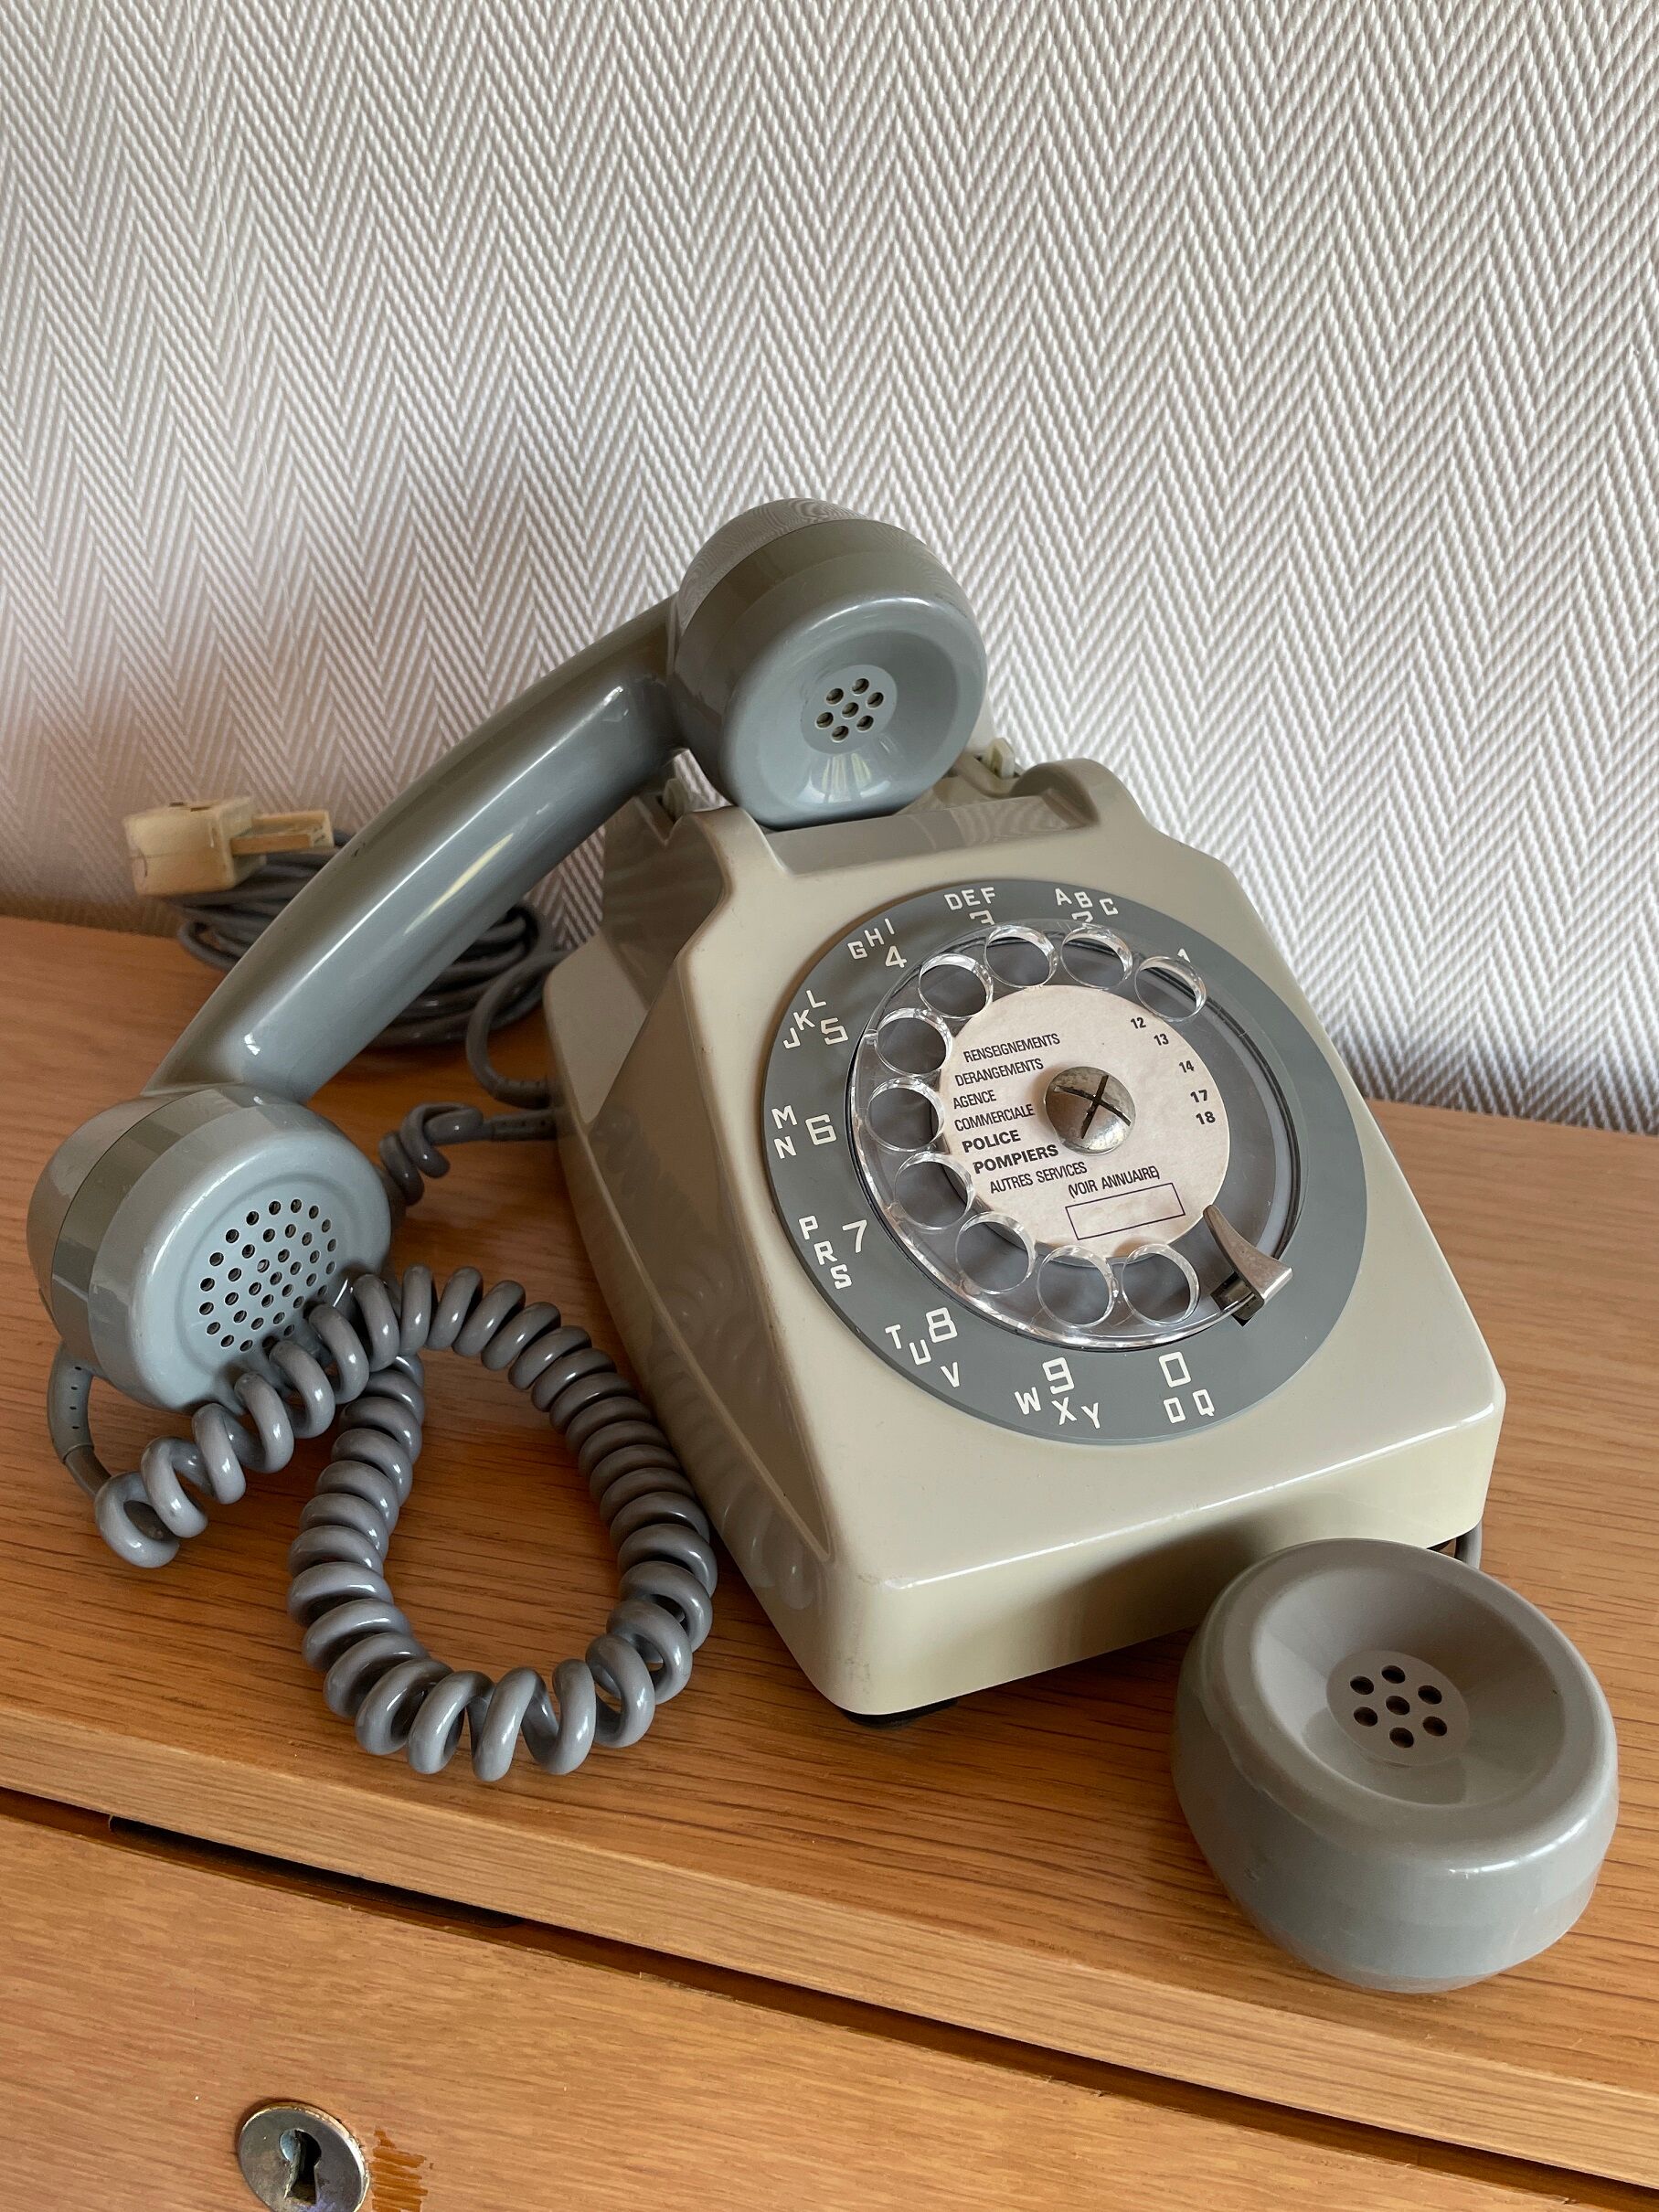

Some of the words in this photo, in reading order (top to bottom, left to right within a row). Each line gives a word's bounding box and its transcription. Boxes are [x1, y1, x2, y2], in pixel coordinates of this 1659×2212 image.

[885, 945, 908, 968] 4
[820, 1017, 849, 1045] 5
[1130, 1016, 1147, 1029] 12
[962, 1033, 1060, 1063] RENSEIGNEMENTS
[1154, 1033, 1169, 1047] 13
[953, 1057, 1044, 1087] DERANGEMENTS
[1178, 1060, 1195, 1073] 14
[952, 1089, 997, 1110] AGENCE
[1190, 1089, 1207, 1103] 17
[804, 1113, 837, 1146] 6
[953, 1103, 1035, 1133] COMMERCIALE
[1196, 1111, 1216, 1125] 18
[962, 1129, 1021, 1154] POLICE
[972, 1143, 1059, 1175] POMPIERS
[990, 1173, 1034, 1194] AUTRES
[1037, 1161, 1088, 1184] SERVICES
[1068, 1179, 1099, 1199] (VOIR
[1101, 1165, 1161, 1191] ANNUAIRE)
[842, 1219, 867, 1254] 7
[925, 1307, 958, 1344] 8
[1042, 1356, 1075, 1395] 9
